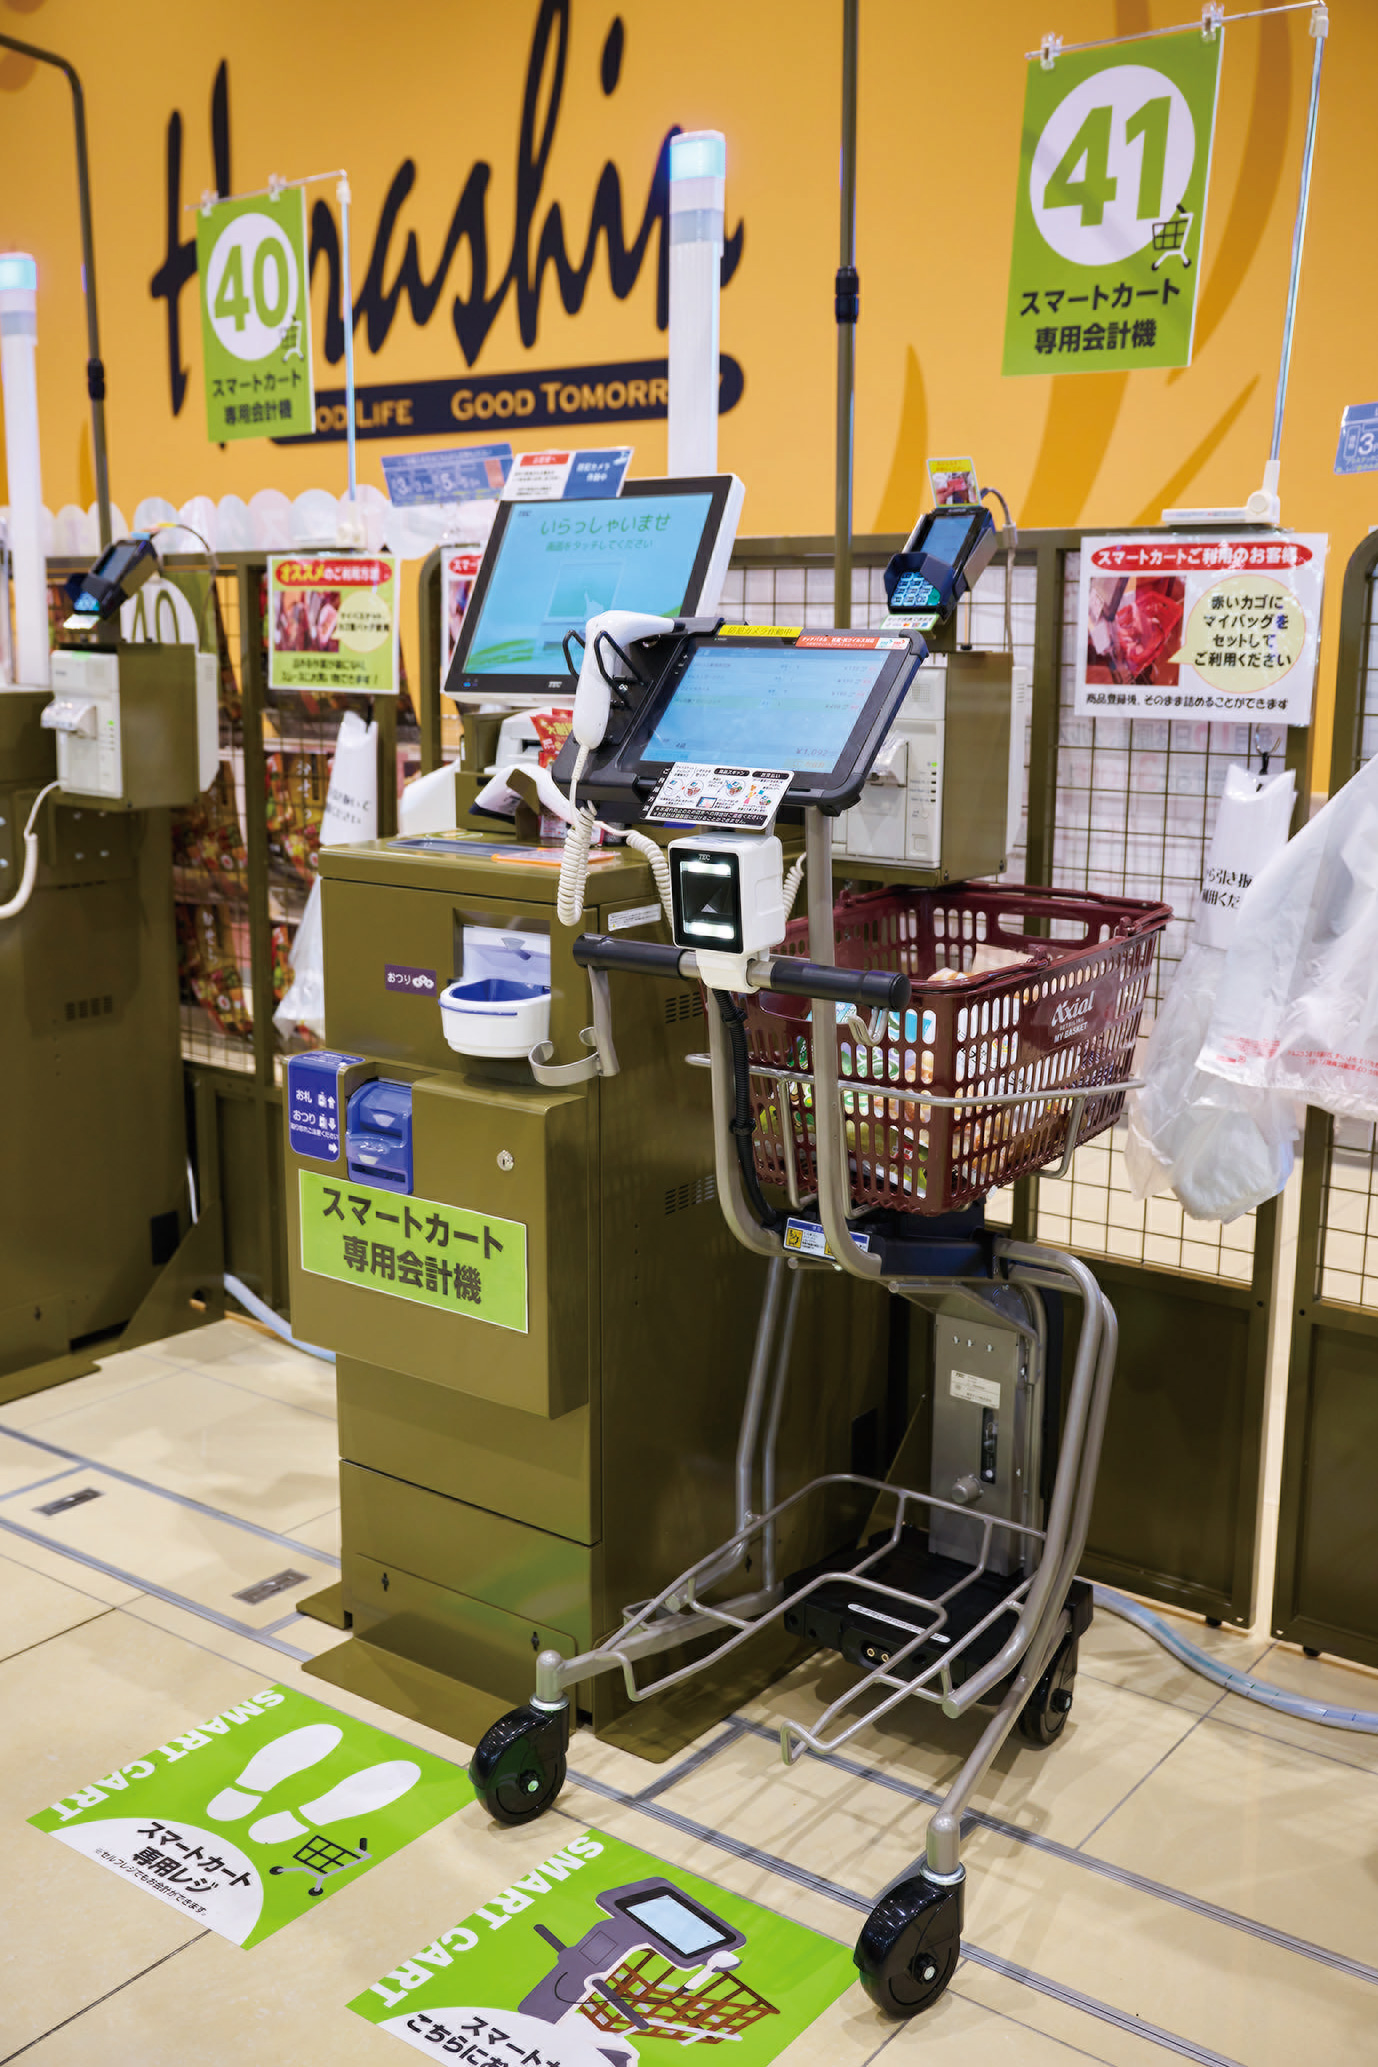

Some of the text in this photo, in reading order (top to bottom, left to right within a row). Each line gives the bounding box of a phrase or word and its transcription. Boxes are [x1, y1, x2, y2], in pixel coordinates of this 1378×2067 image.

[1043, 96, 1172, 227] 41
[213, 236, 289, 332] 40
[1020, 278, 1181, 316] スマートカート
[1034, 319, 1156, 354] 専用会計機
[212, 369, 302, 397] スマートカート
[224, 399, 294, 427] 専用会計機
[355, 398, 413, 428] LIFE
[451, 389, 535, 421] GOOD
[540, 379, 668, 413] TOMORR
[541, 514, 671, 536] いらっしゃいませ
[546, 539, 653, 552] 画面をタッチしてください
[1211, 595, 1283, 609] 赤いカゴに
[727, 626, 792, 635] 防犯カメラ作動中
[1204, 614, 1288, 629] マイバッグを
[1213, 634, 1276, 648] セットして
[1194, 653, 1291, 668] ご利用ください
[387, 972, 411, 985] おつり
[1051, 990, 1095, 1027] Axial
[1054, 1021, 1088, 1043] MY BASKET
[296, 1089, 312, 1103] お札
[293, 1110, 316, 1125] おつり
[322, 1187, 503, 1258] スマートカート
[343, 1235, 482, 1305] 専用会計機
[54, 1689, 286, 1822] SMART CART
[132, 1846, 219, 1894] 専用レジ
[137, 1822, 252, 1887] スマートカート
[368, 1837, 605, 2008] SMART CART
[461, 2016, 562, 2067] スマート
